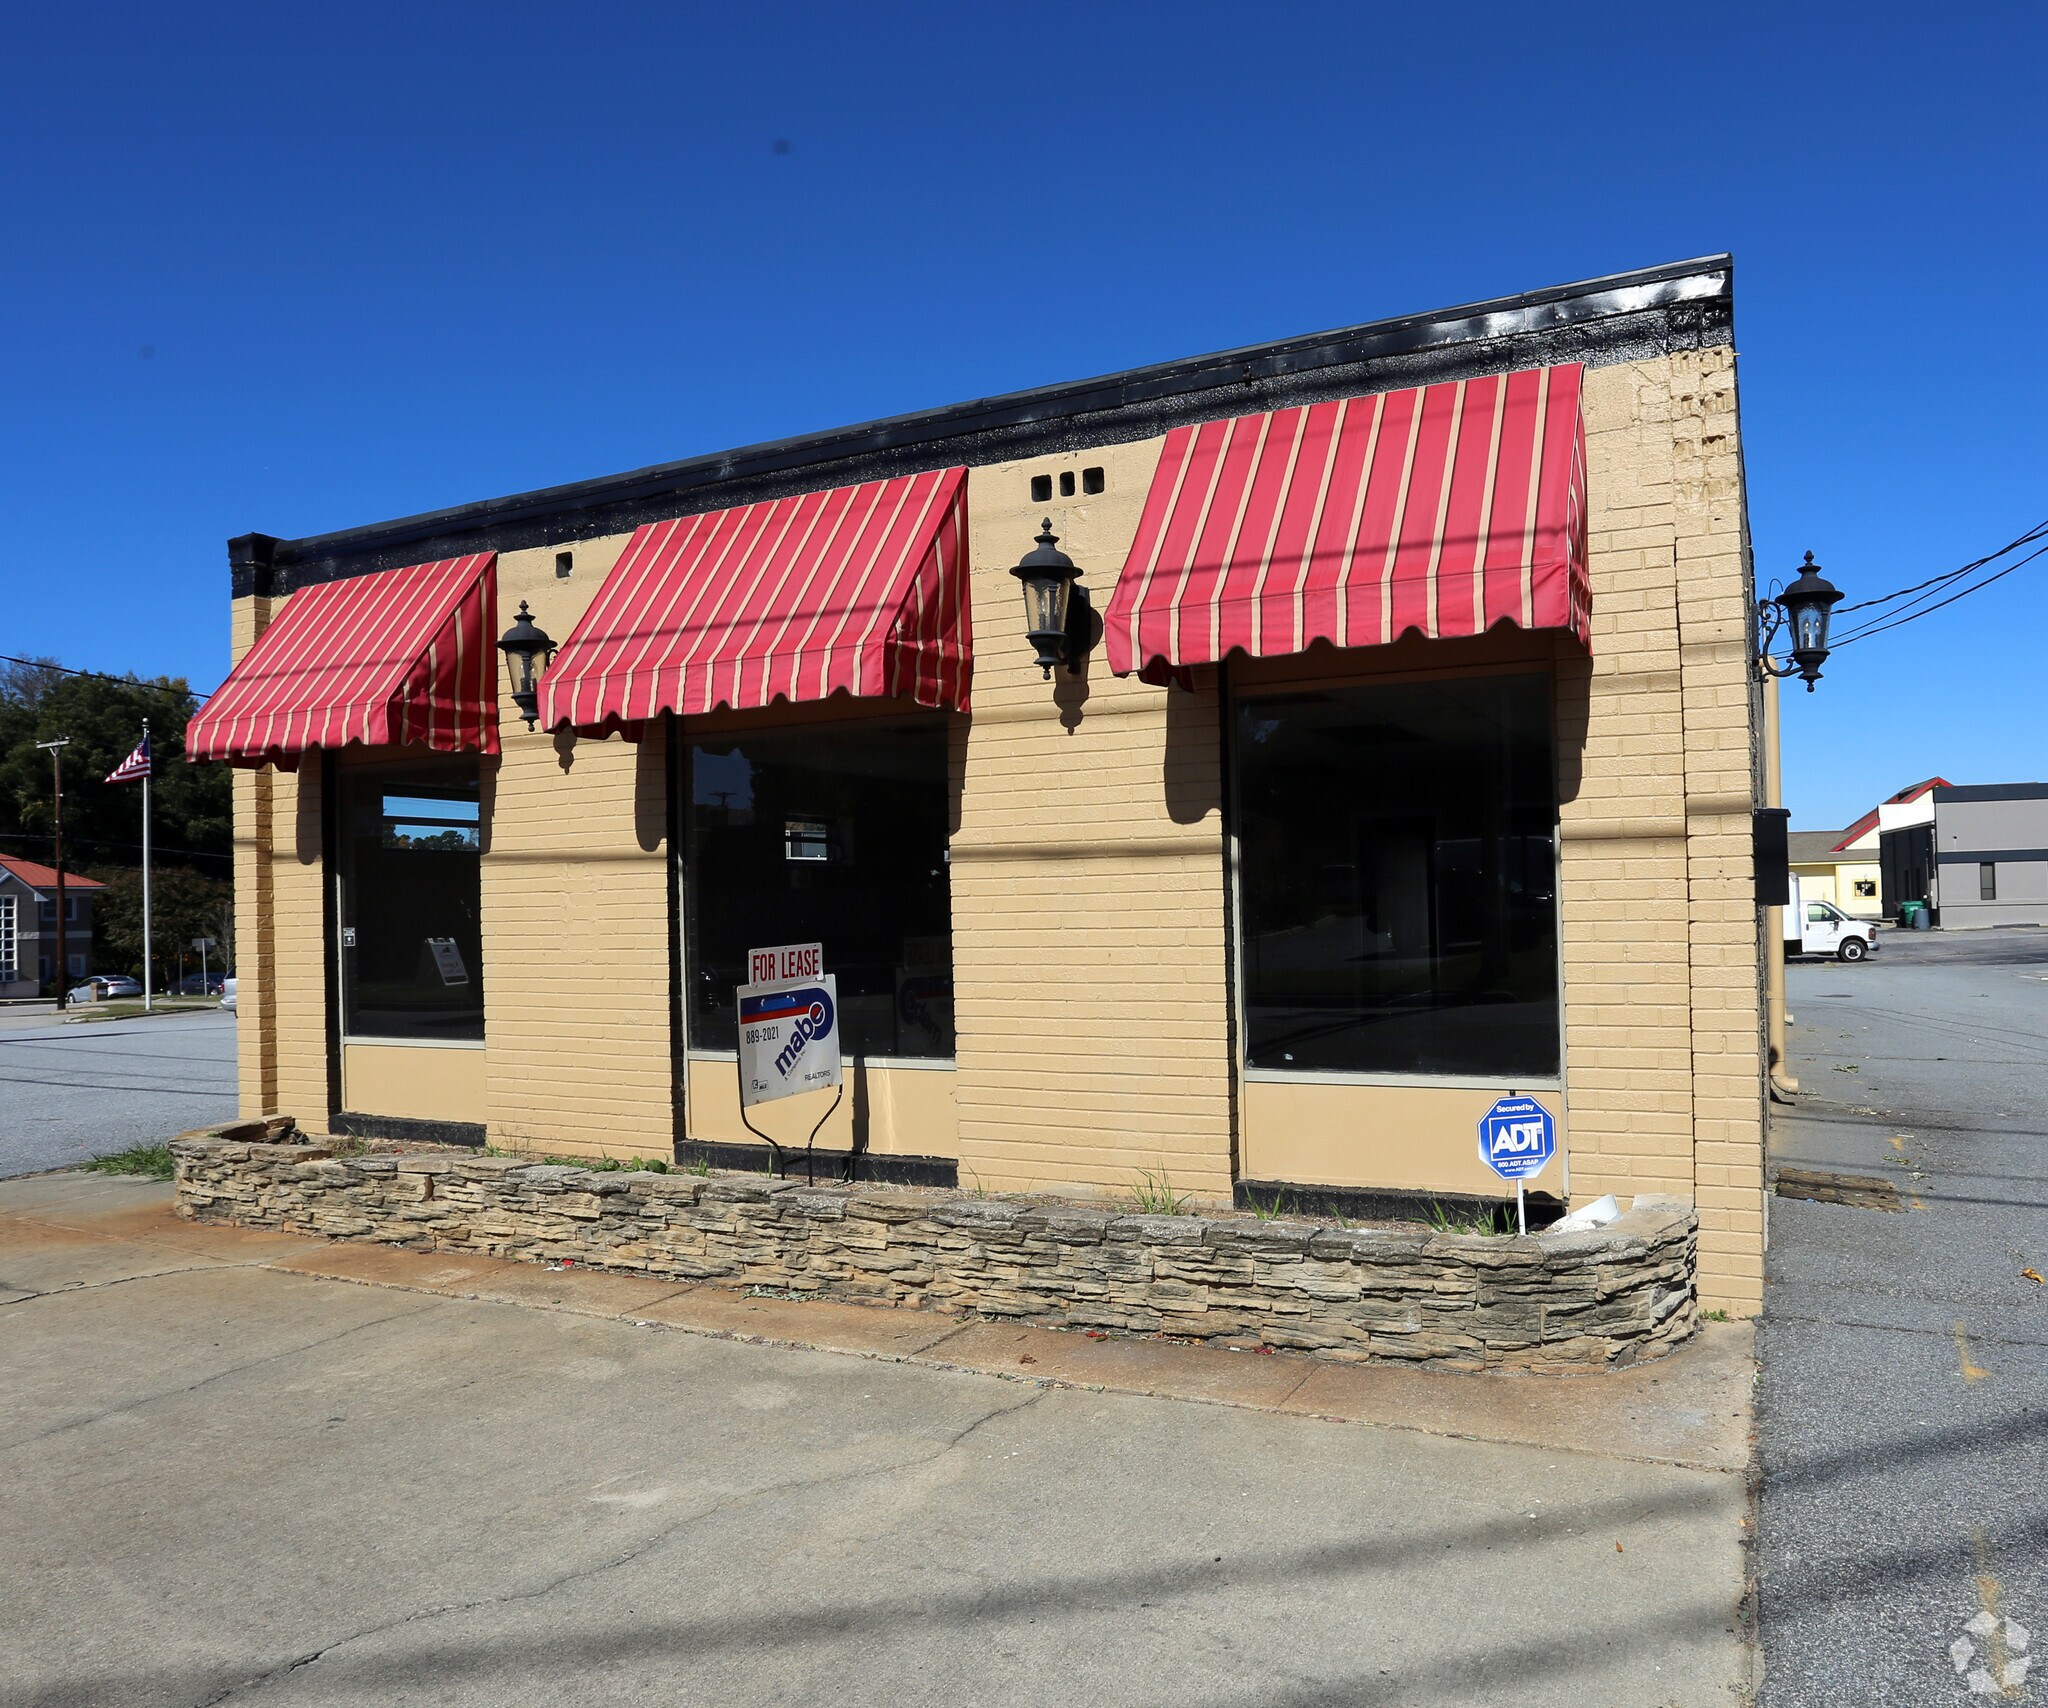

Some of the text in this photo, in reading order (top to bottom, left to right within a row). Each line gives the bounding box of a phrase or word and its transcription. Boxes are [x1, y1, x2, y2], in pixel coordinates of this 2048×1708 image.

[752, 949, 819, 983] FOR LEASE
[746, 1026, 779, 1044] 889-2021
[804, 1069, 831, 1081] REALTORS
[1496, 1103, 1534, 1113] Secured by
[1492, 1121, 1542, 1154] ADT
